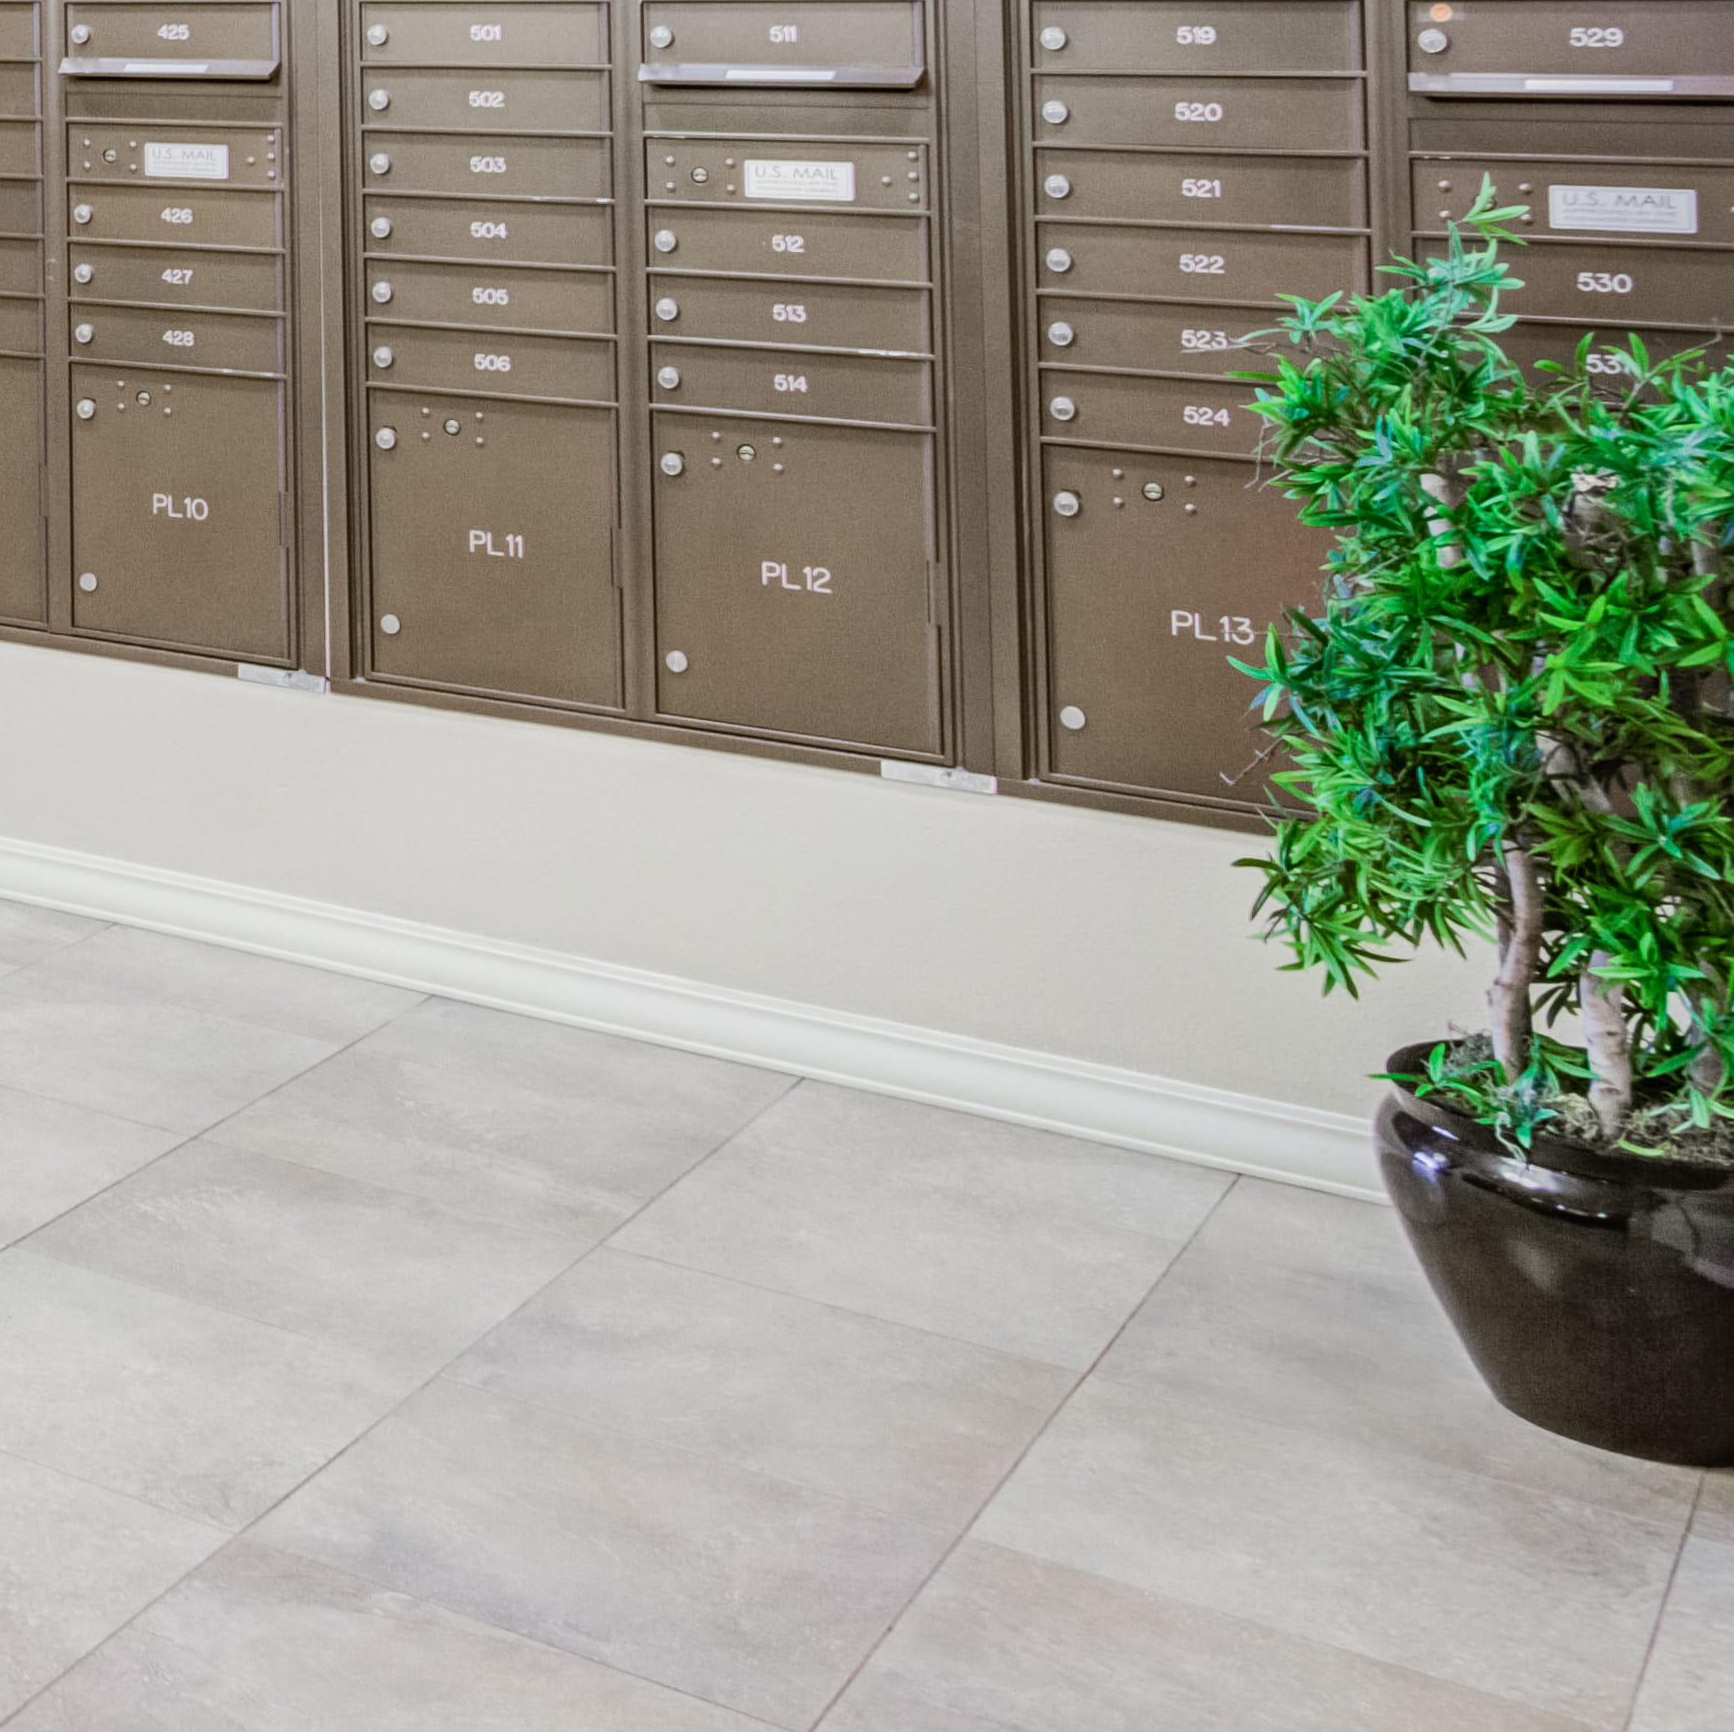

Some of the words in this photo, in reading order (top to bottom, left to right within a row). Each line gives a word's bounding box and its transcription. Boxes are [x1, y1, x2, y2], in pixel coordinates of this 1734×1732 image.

[156, 23, 190, 41] 425
[469, 24, 502, 41] 501
[769, 25, 797, 43] 511
[1176, 25, 1217, 45] 519
[1569, 27, 1624, 48] 529
[468, 90, 505, 108] 502
[1174, 101, 1223, 122] 520
[181, 149, 216, 161] MAIL
[469, 155, 507, 174] 503
[793, 167, 838, 180] MAIL
[1181, 178, 1221, 198] 521
[1614, 194, 1677, 210] MAIL
[160, 207, 193, 224] 426
[470, 221, 508, 239] 504
[771, 234, 805, 253] 512
[1179, 253, 1225, 274] 522
[161, 268, 194, 285] 427
[1576, 271, 1633, 294] 530
[472, 287, 510, 306] 505
[772, 303, 807, 323] 513
[162, 329, 195, 347] 428
[1181, 329, 1228, 349] 523
[474, 353, 511, 372] 506
[1585, 353, 1632, 375] 53
[773, 373, 808, 393] 514
[1183, 405, 1231, 427] 524
[152, 492, 209, 521] PL10
[469, 529, 524, 559] PL11
[761, 560, 833, 594] PL12
[1171, 610, 1254, 645] PL13
